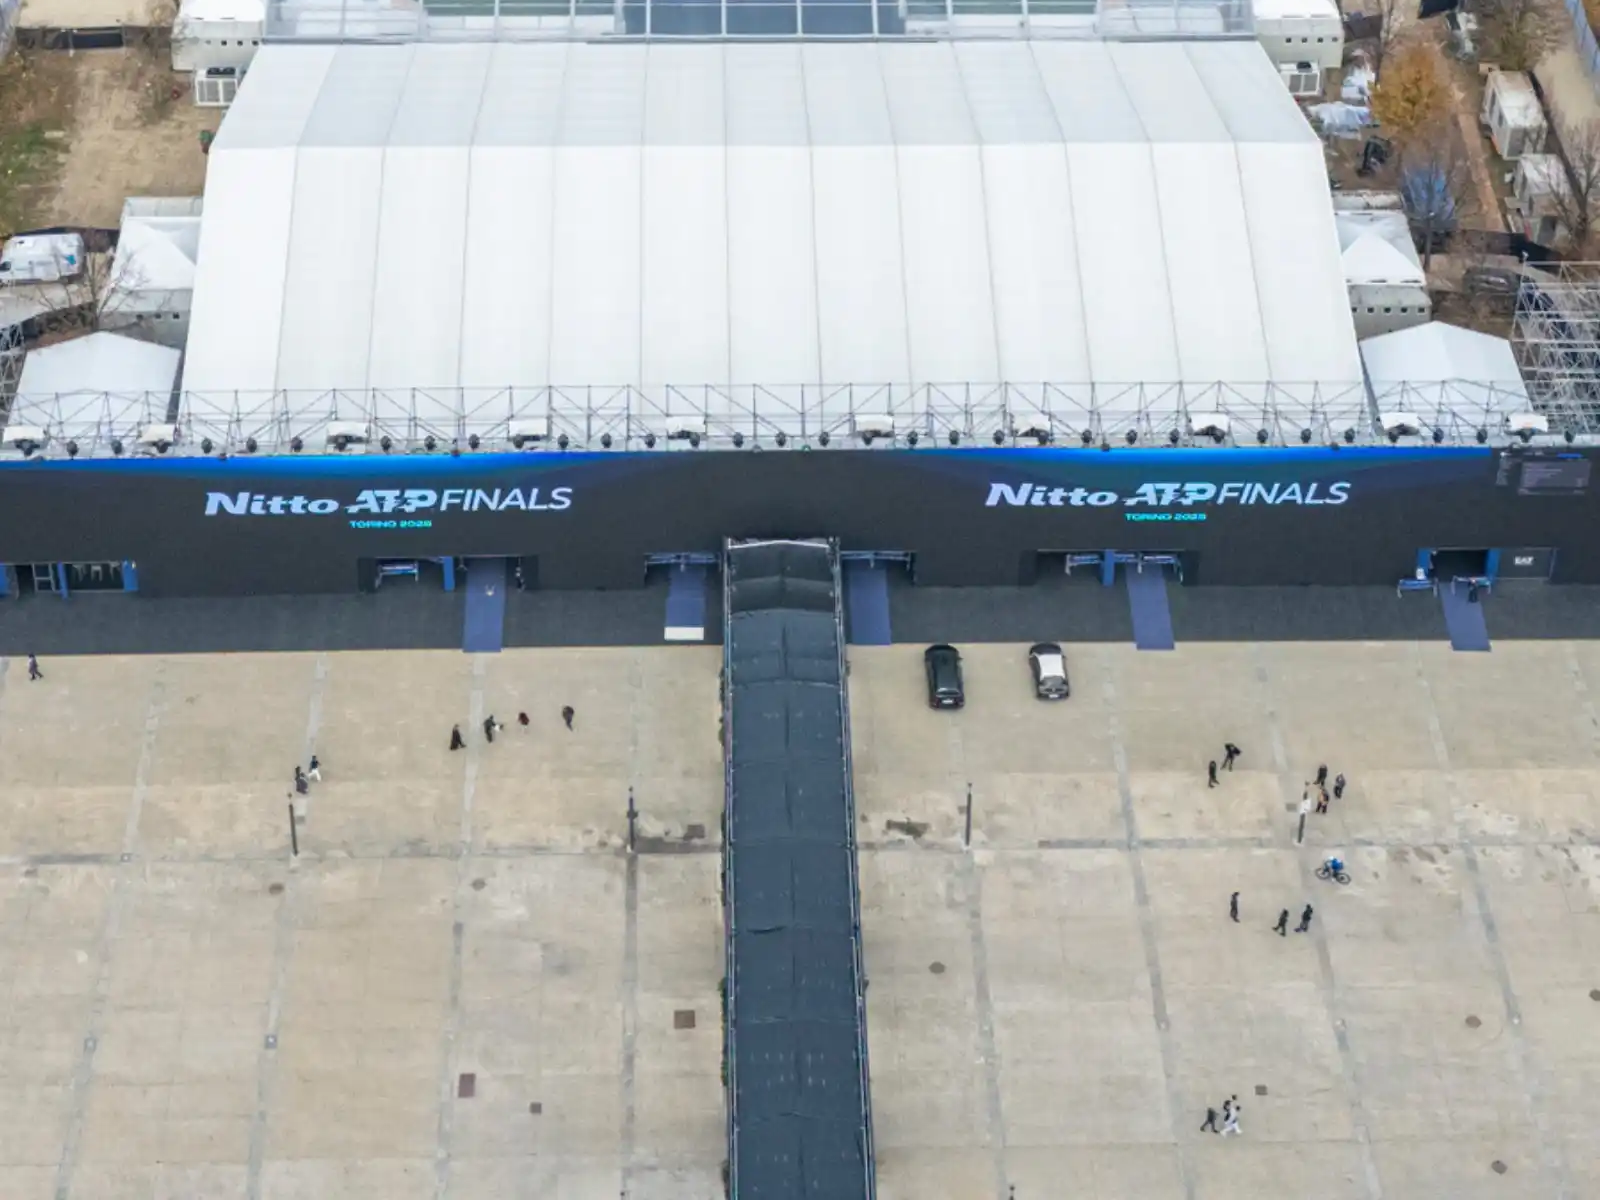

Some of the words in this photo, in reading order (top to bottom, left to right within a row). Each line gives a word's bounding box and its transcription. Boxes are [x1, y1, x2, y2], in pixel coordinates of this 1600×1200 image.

[204, 491, 339, 515] Nitto
[344, 489, 437, 513] ATP
[439, 487, 573, 511] FINALS
[984, 483, 1118, 506] Nitto
[1122, 482, 1217, 506] ATP
[1217, 482, 1352, 505] FINALS
[348, 520, 397, 529] TORINO
[1124, 512, 1172, 521] TORINO
